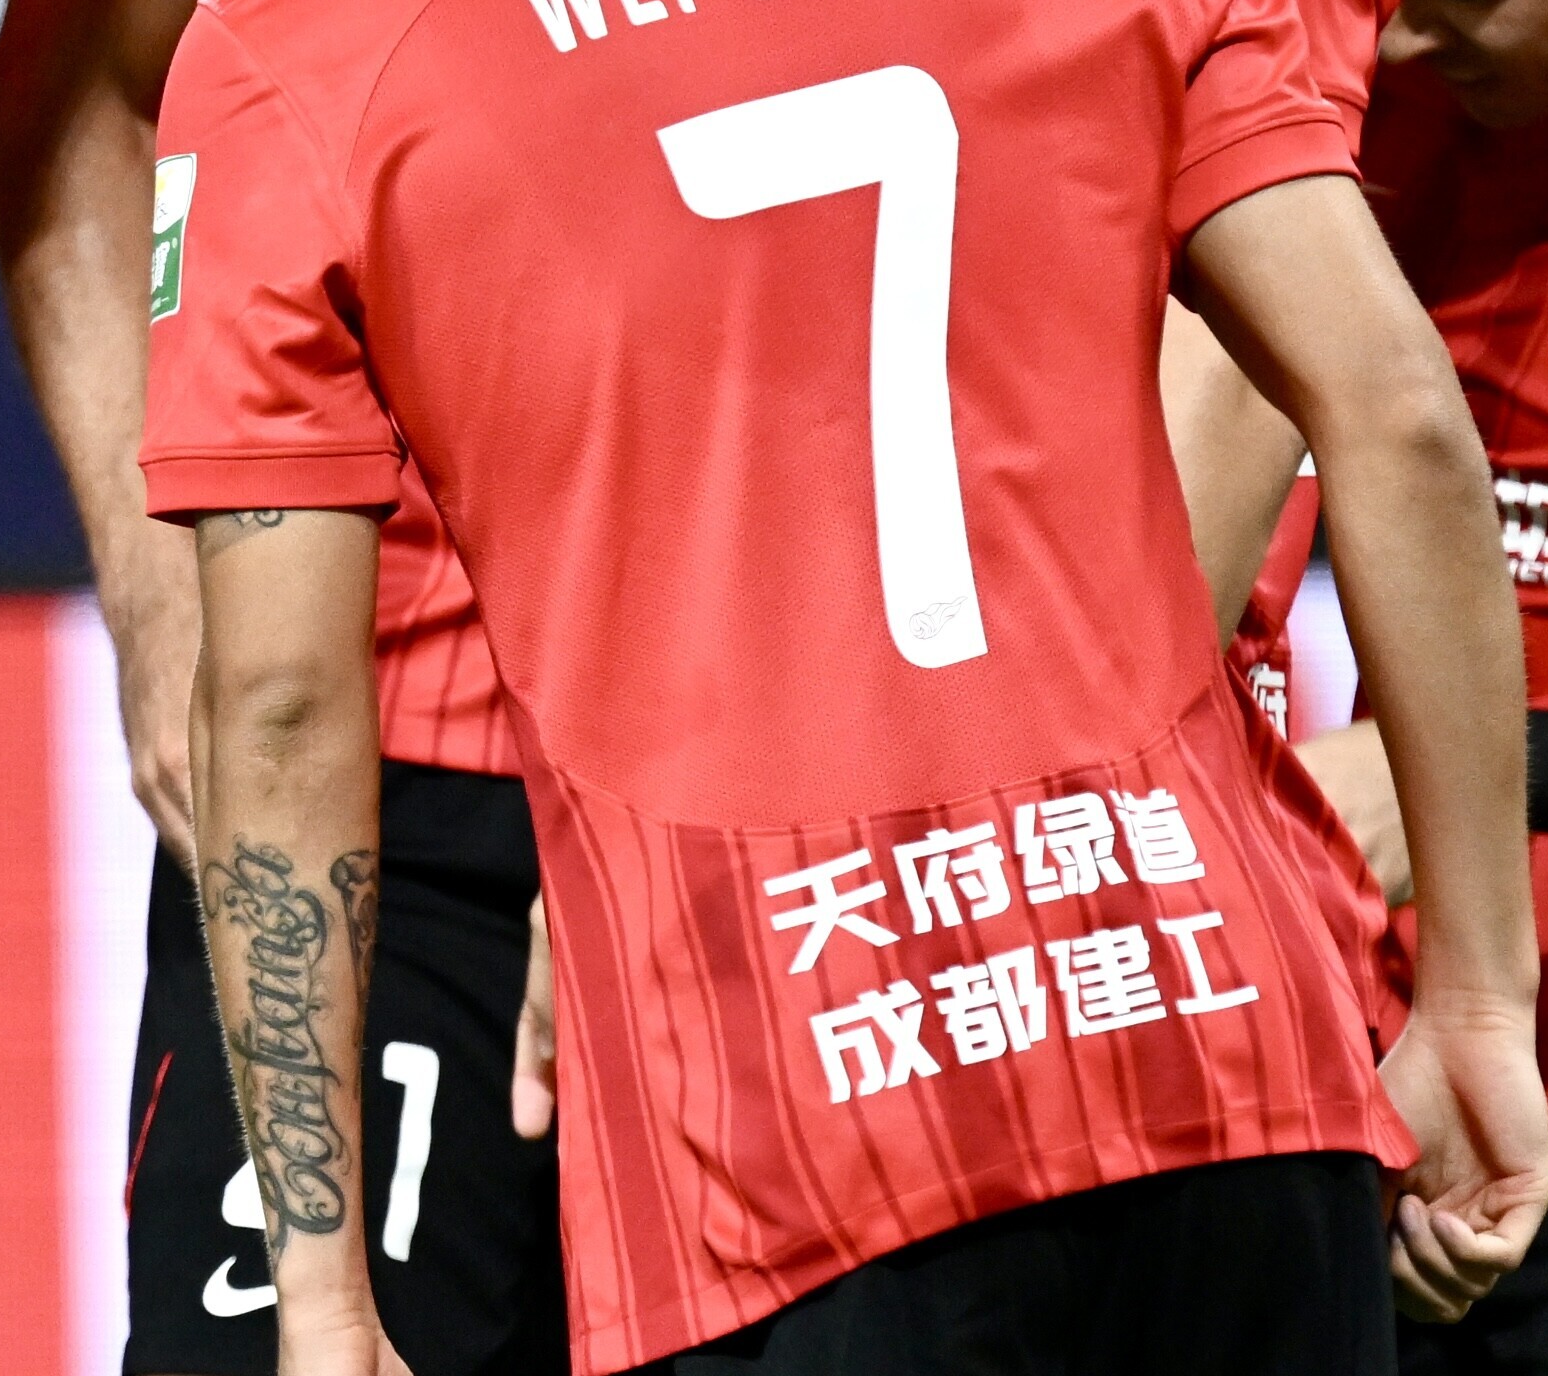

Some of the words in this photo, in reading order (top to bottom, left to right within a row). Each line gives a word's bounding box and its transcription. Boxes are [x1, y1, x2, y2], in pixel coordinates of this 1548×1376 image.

[657, 65, 988, 670] 7
[764, 787, 1205, 975] 天府绿道
[809, 911, 1260, 1104] 成都建工
